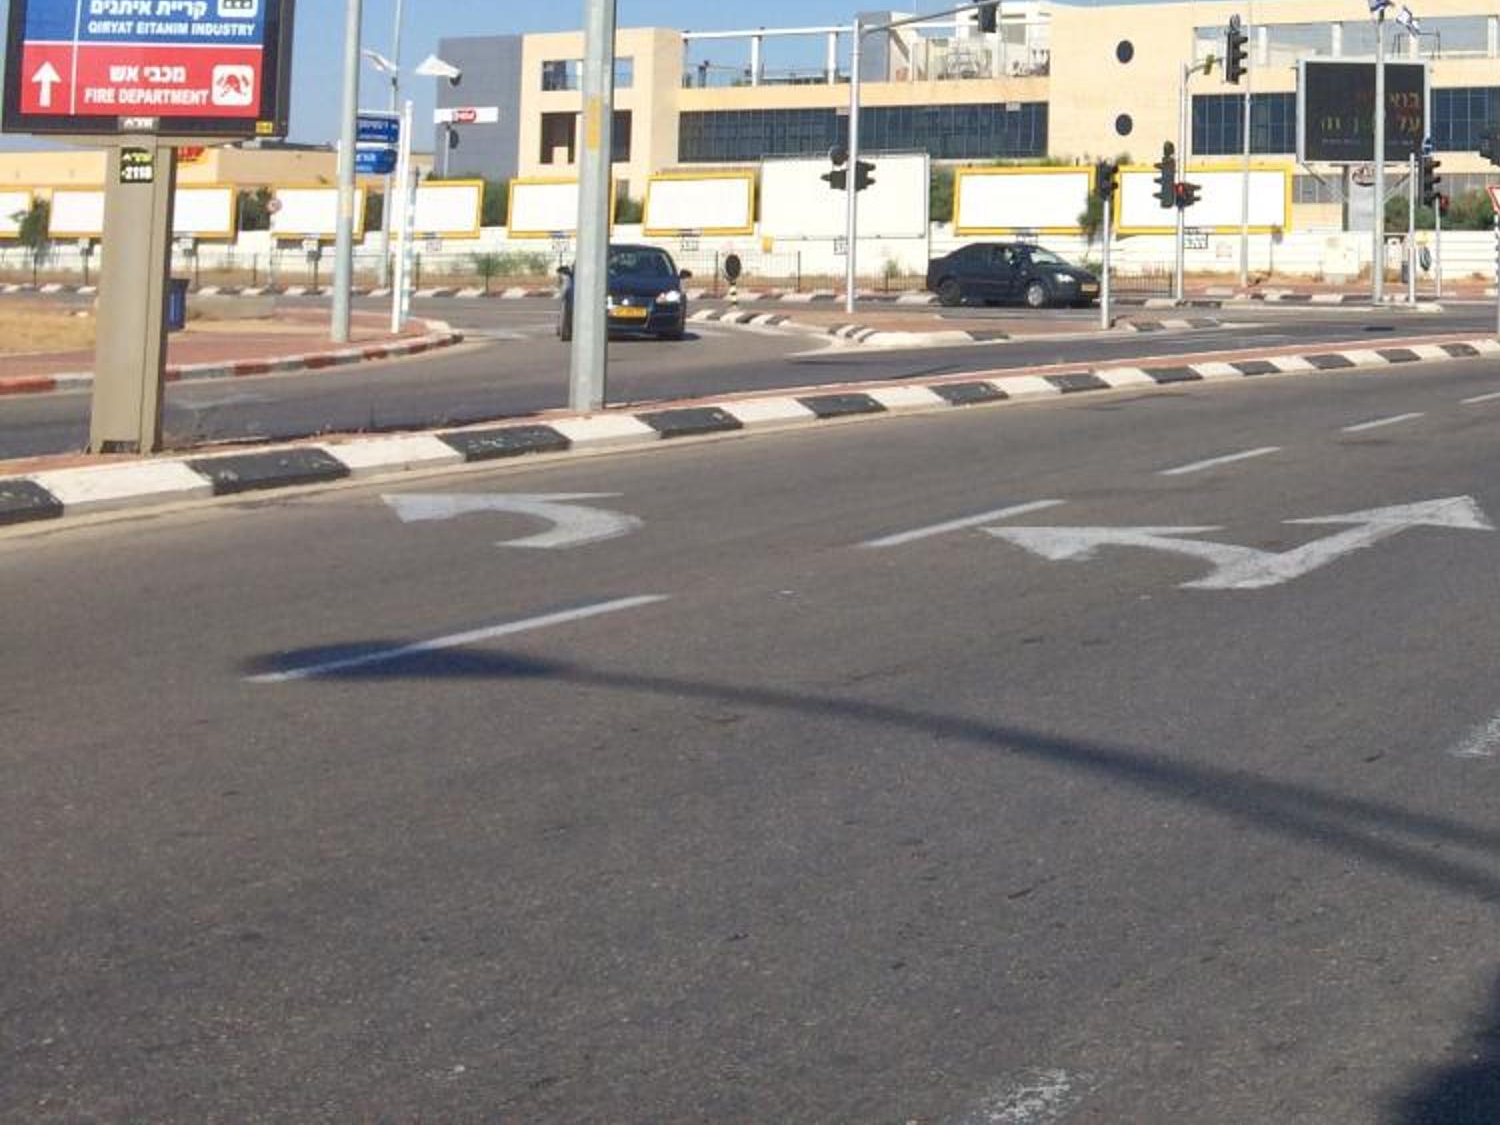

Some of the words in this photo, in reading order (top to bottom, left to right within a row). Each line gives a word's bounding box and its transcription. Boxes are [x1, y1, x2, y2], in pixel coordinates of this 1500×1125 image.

[156, 0, 207, 20] קריית
[88, 20, 136, 34] QIRYAT
[136, 21, 188, 35] EITANIM
[191, 22, 256, 36] INDUSTRY
[109, 65, 140, 83] אש
[143, 66, 187, 83] מכבי
[84, 87, 115, 104] FIRE
[118, 88, 209, 105] DEPARTMENT
